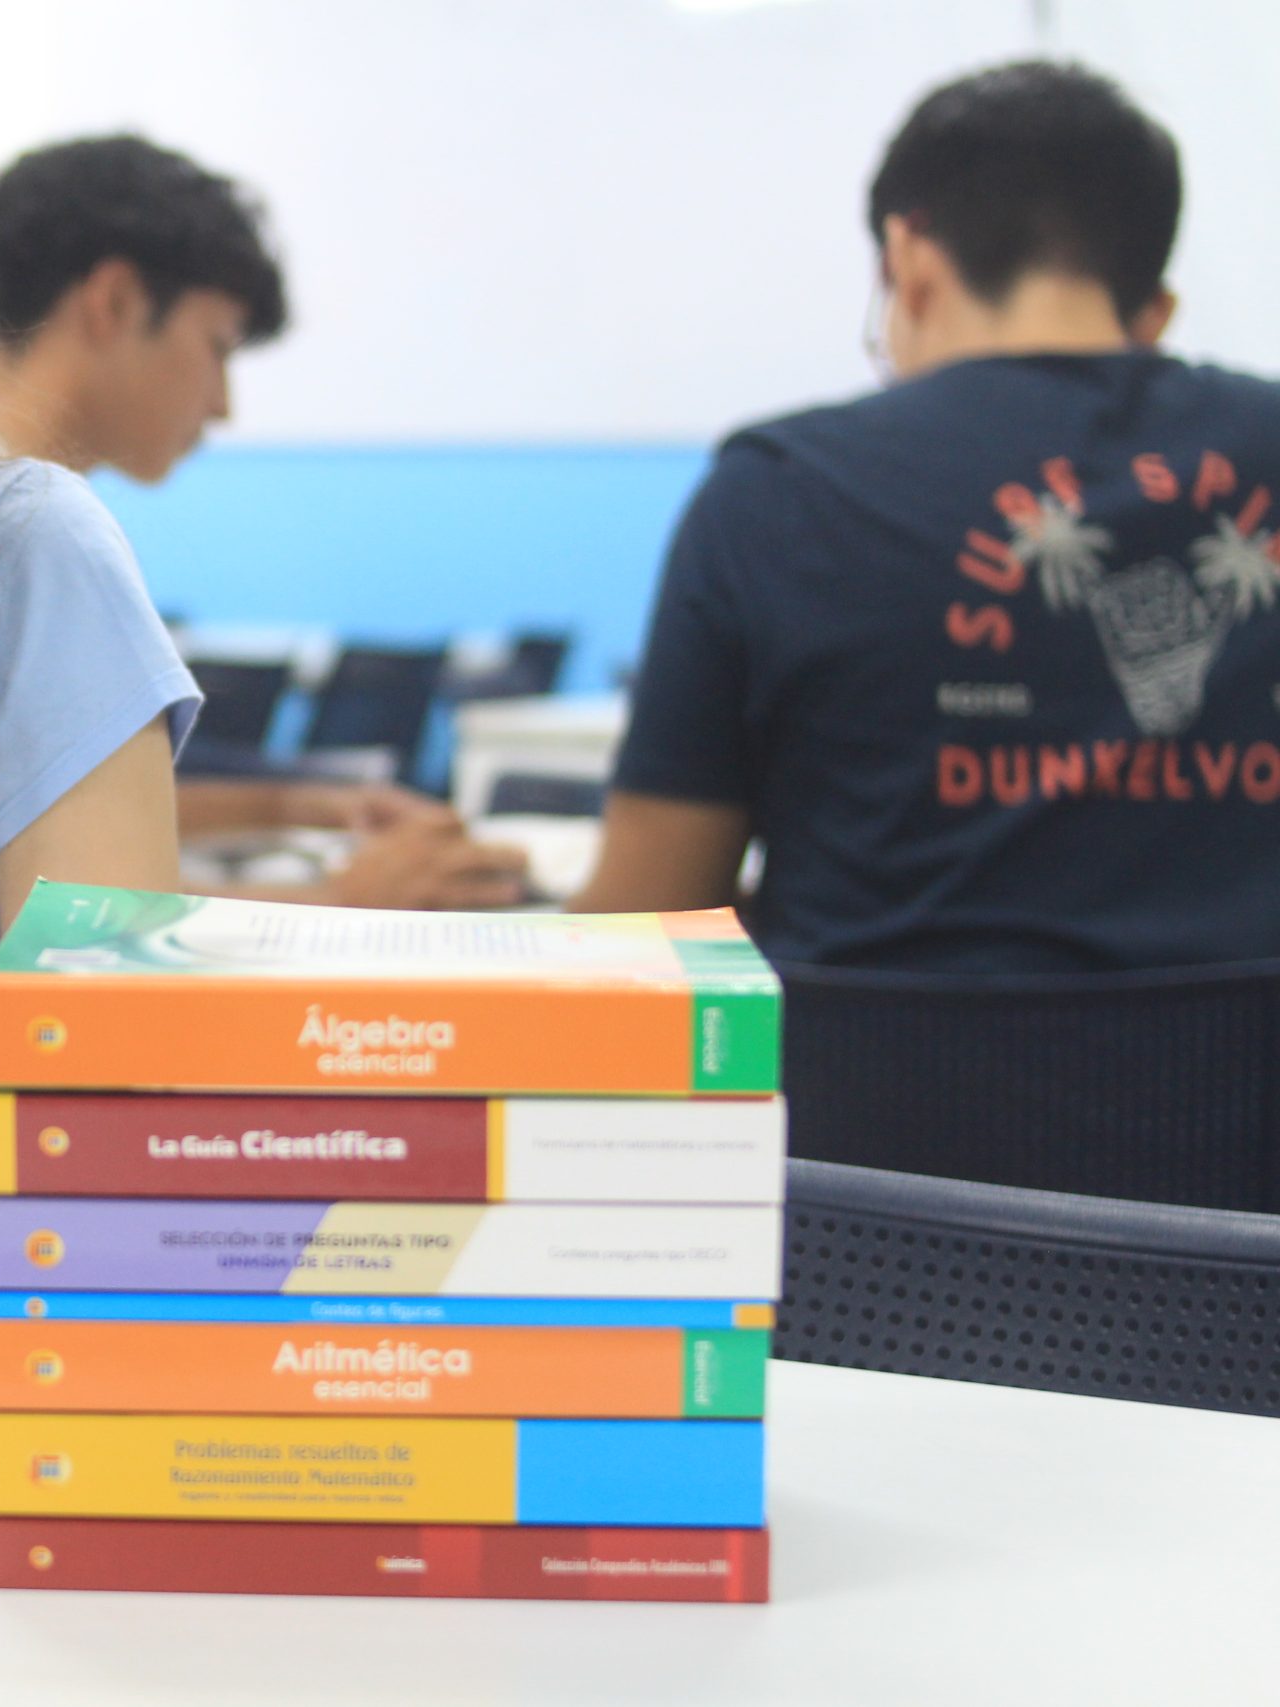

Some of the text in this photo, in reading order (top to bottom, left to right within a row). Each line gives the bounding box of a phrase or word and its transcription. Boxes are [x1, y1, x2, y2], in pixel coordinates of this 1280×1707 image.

[297, 1003, 456, 1054] Álgebra
[317, 1051, 436, 1075] esencial
[148, 1130, 408, 1160] La Guía Científica
[264, 1232, 287, 1248] DE
[292, 1232, 402, 1249] PREGUNTAS
[410, 1233, 452, 1249] TIPO
[294, 1255, 317, 1269] DE
[324, 1255, 393, 1270] LETRAS
[273, 1339, 473, 1374] Aritmética
[314, 1376, 430, 1400] esencial
[174, 1440, 281, 1460] Problemas
[386, 1442, 411, 1462] de
